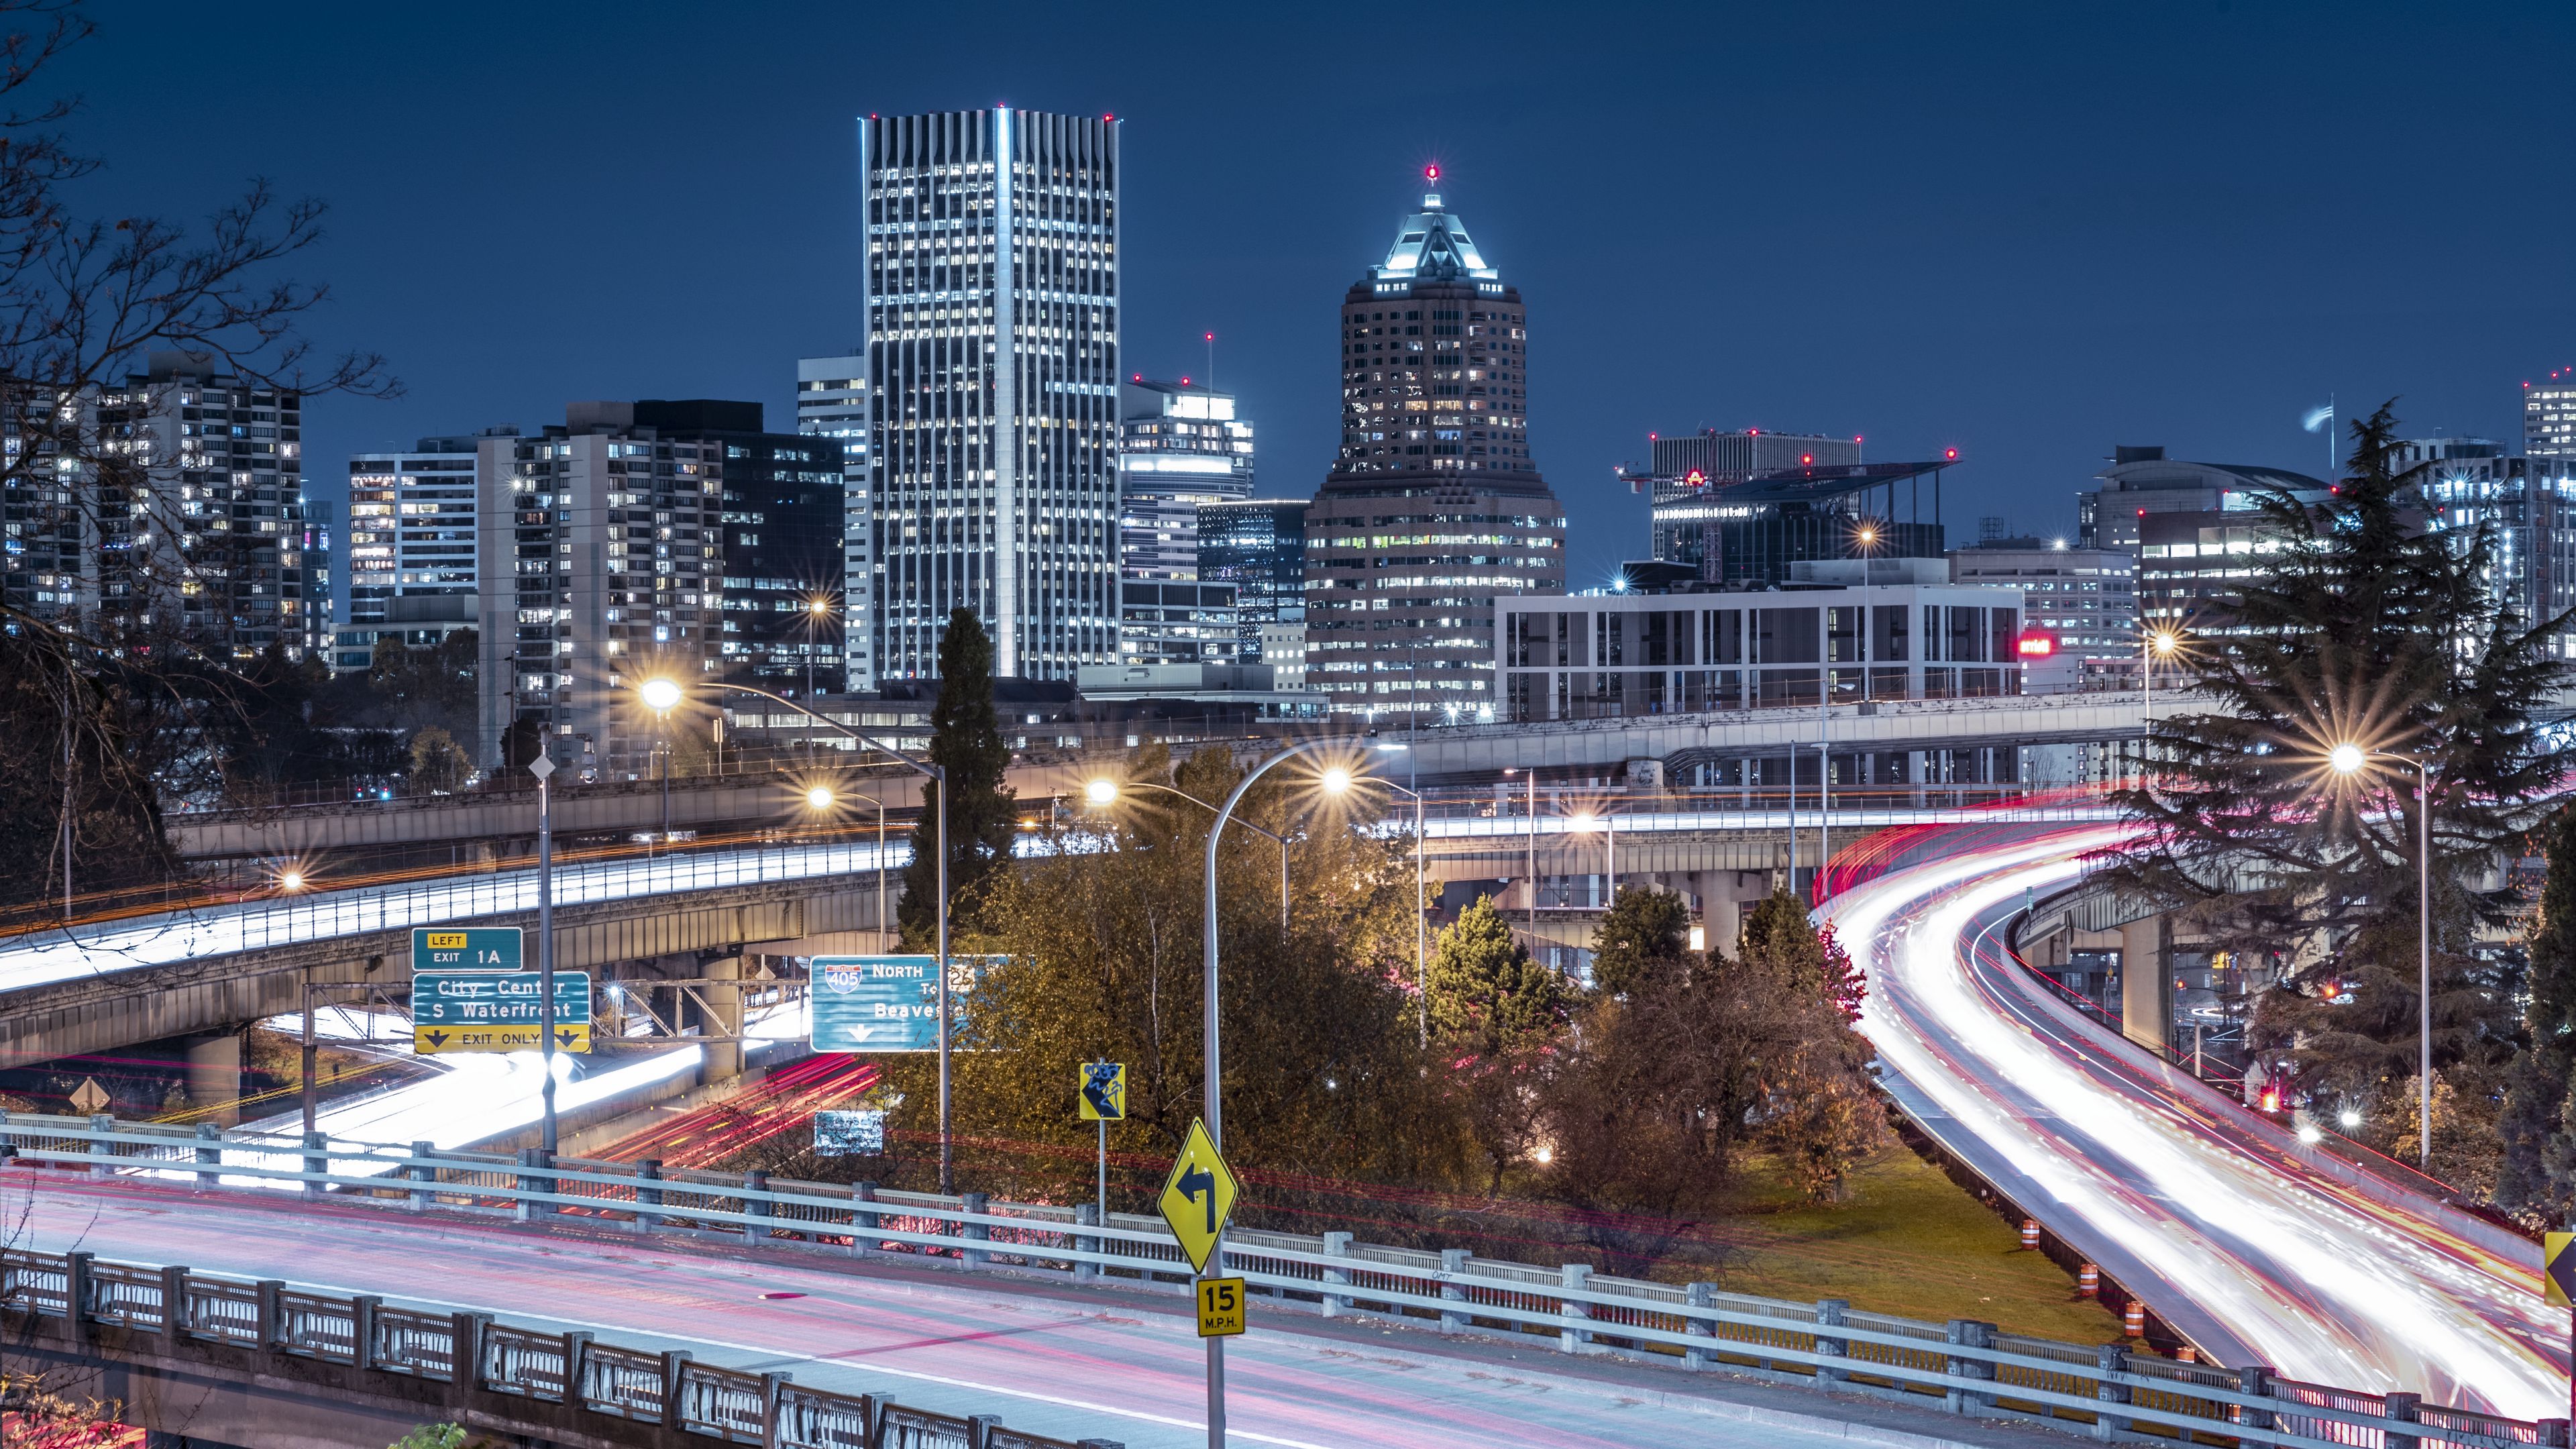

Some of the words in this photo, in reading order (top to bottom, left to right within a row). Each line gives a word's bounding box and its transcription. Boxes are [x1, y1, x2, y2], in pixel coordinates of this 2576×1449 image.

[432, 936, 462, 945] LEFT
[434, 953, 460, 963] EXIT
[478, 949, 501, 964] 1A
[872, 963, 923, 978] NORTH
[828, 972, 859, 986] 405
[951, 971, 973, 985] 26
[437, 980, 478, 998] City
[498, 979, 565, 995] Centr
[433, 1004, 444, 1018] S
[462, 1034, 493, 1044] EXIT
[501, 1033, 541, 1045] ONLY
[1206, 1285, 1235, 1312] 15
[1205, 1317, 1237, 1329] M.P.H.
